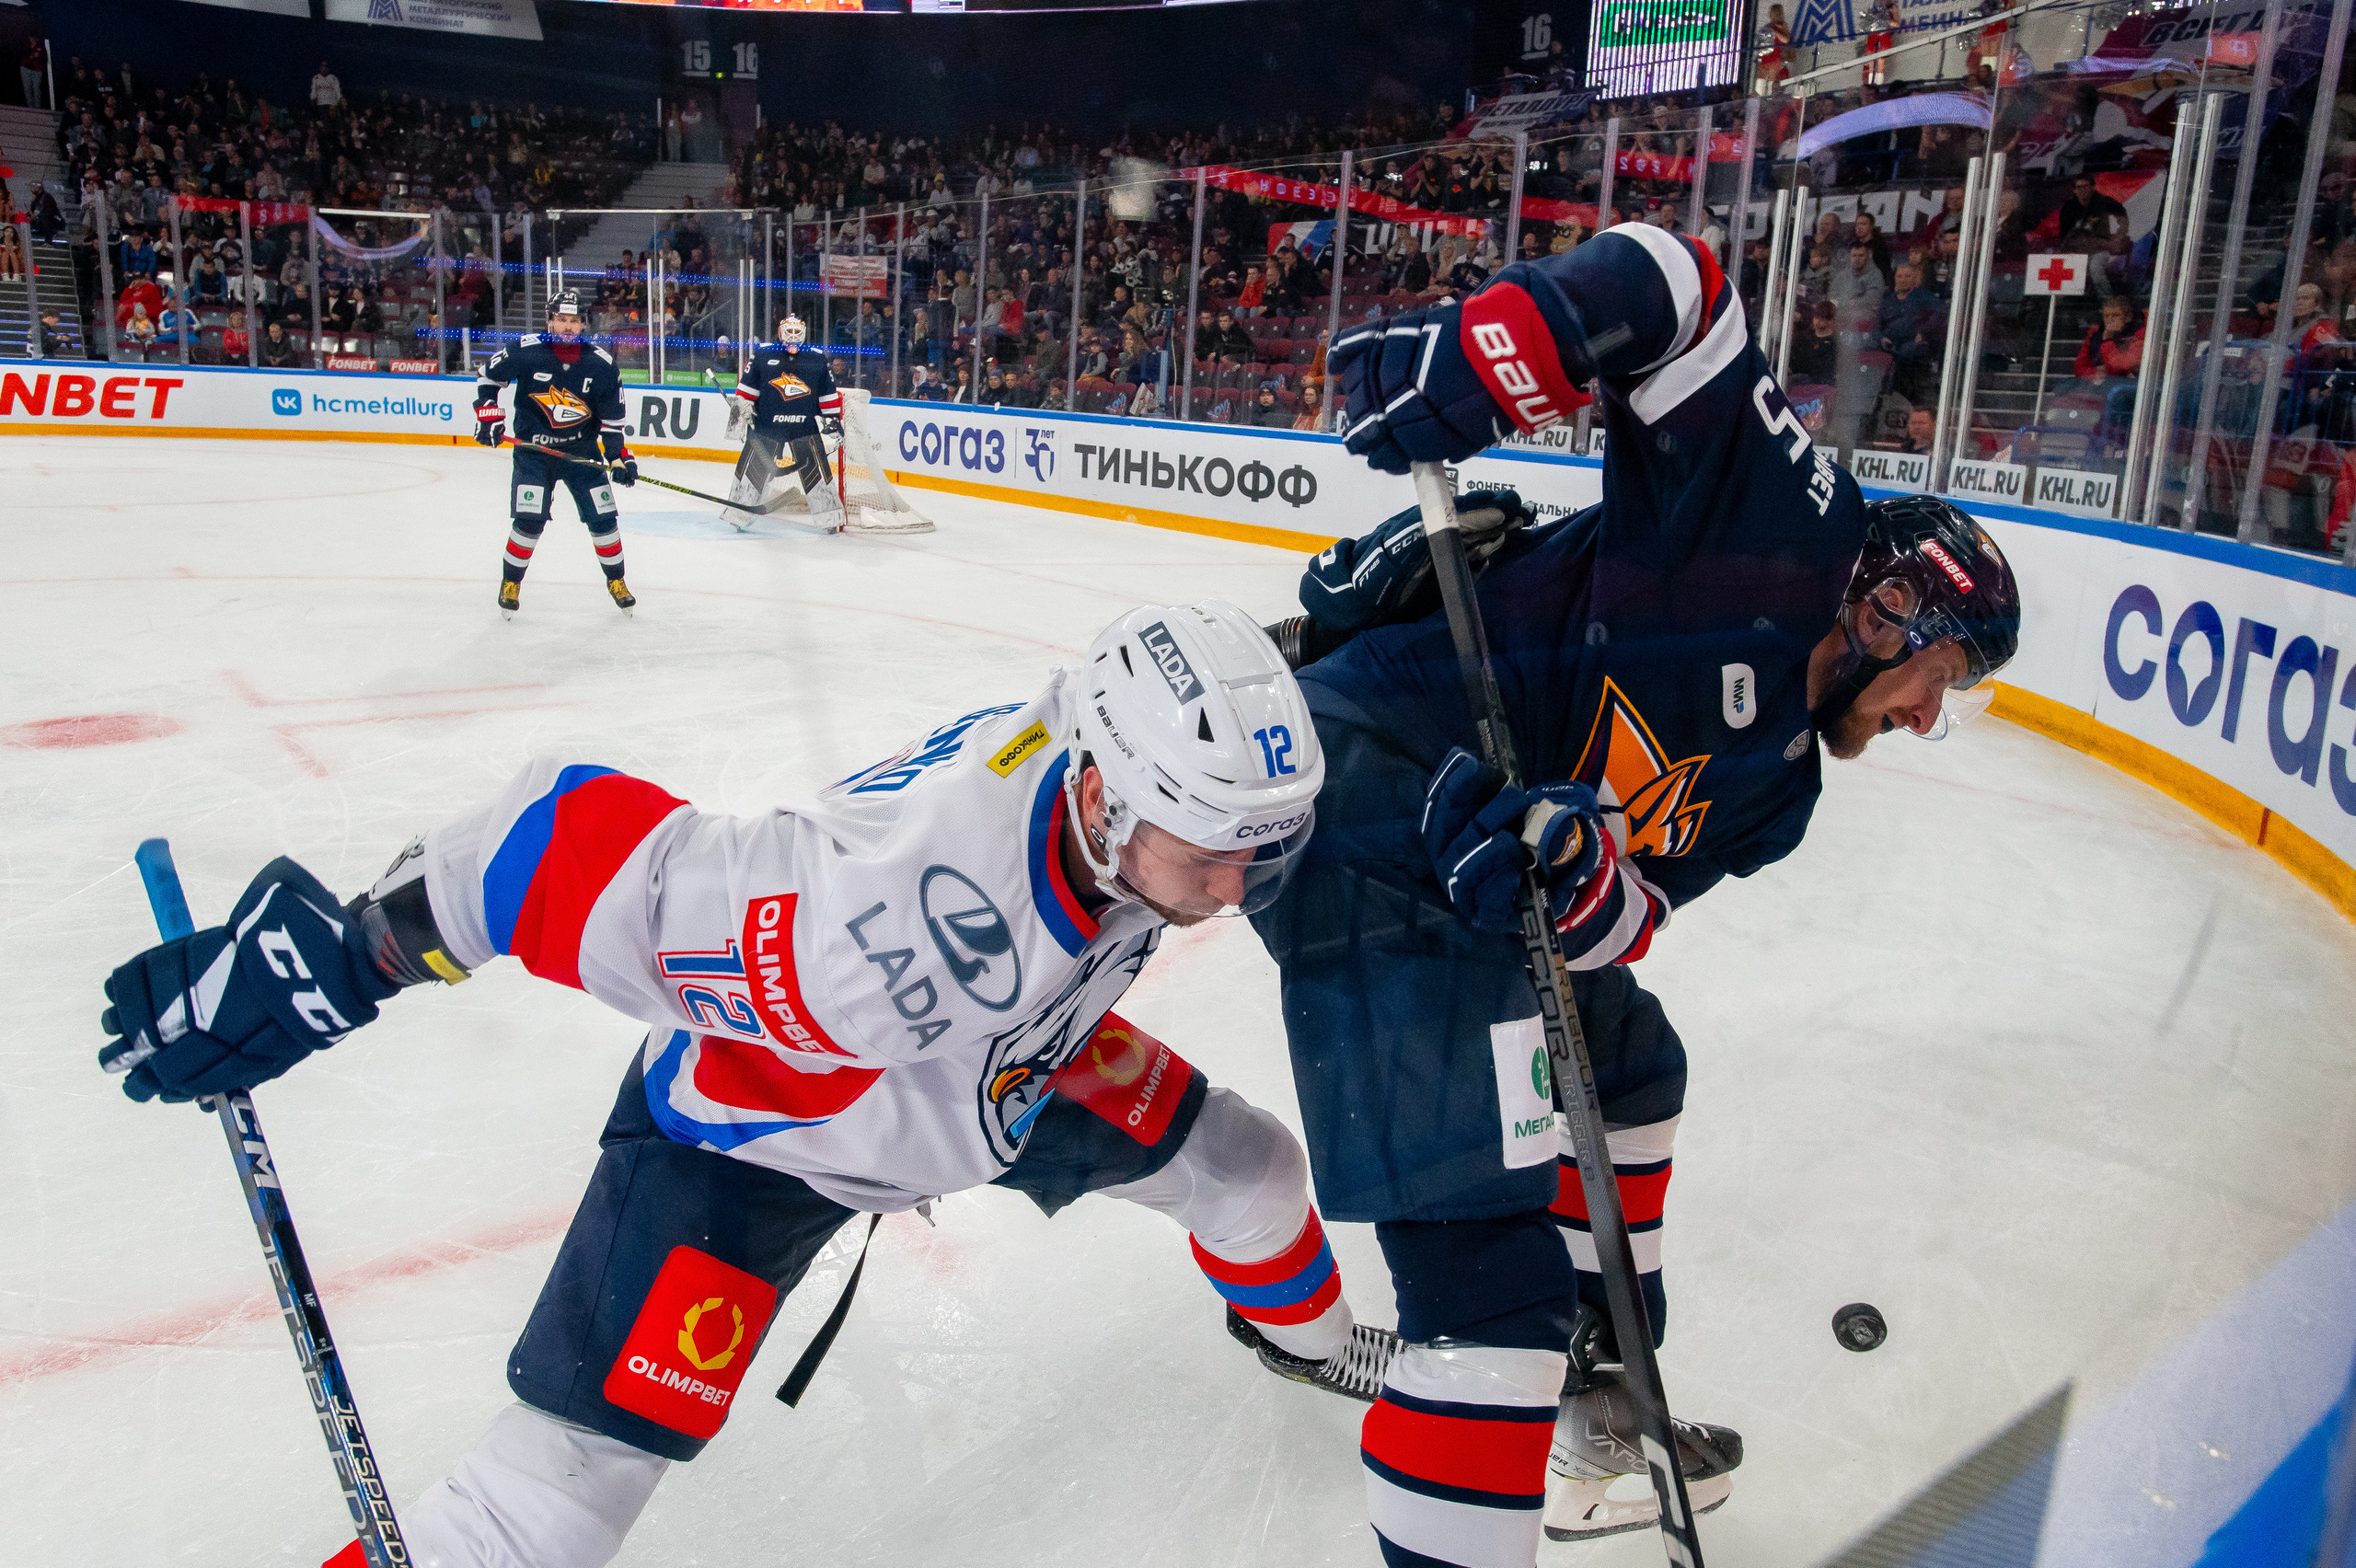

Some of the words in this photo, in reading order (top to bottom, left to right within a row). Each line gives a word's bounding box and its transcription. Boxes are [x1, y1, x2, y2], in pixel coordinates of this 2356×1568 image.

[682, 40, 711, 71] 15
[1520, 13, 1552, 52] 16
[328, 359, 375, 372] FONBET
[390, 361, 437, 374] FONBET
[313, 394, 454, 421] hcmetallurg
[772, 414, 807, 424] FONBET
[1074, 443, 1318, 509] ТИНЬКОФФ
[1856, 457, 1924, 484] KHL.RU
[1951, 465, 2021, 496] KHL.RU
[2038, 475, 2112, 509] KHL.RU
[1923, 542, 1973, 588] FONBET
[1144, 628, 1197, 698] LADA
[999, 728, 1045, 767] ТИНЬКОФФ
[1253, 724, 1297, 778] 12
[258, 922, 352, 1043] CC
[656, 938, 767, 1040] 12
[844, 900, 953, 1051] LADA
[1521, 905, 1571, 1061] BCOR
[1127, 1044, 1171, 1126] OLIMPBET
[230, 1095, 282, 1190] CM
[303, 1292, 318, 1308] MF
[628, 1355, 732, 1407] OLIMPBET
[1585, 1418, 1649, 1471] VAPO
[332, 1394, 408, 1565] JETSPEED
